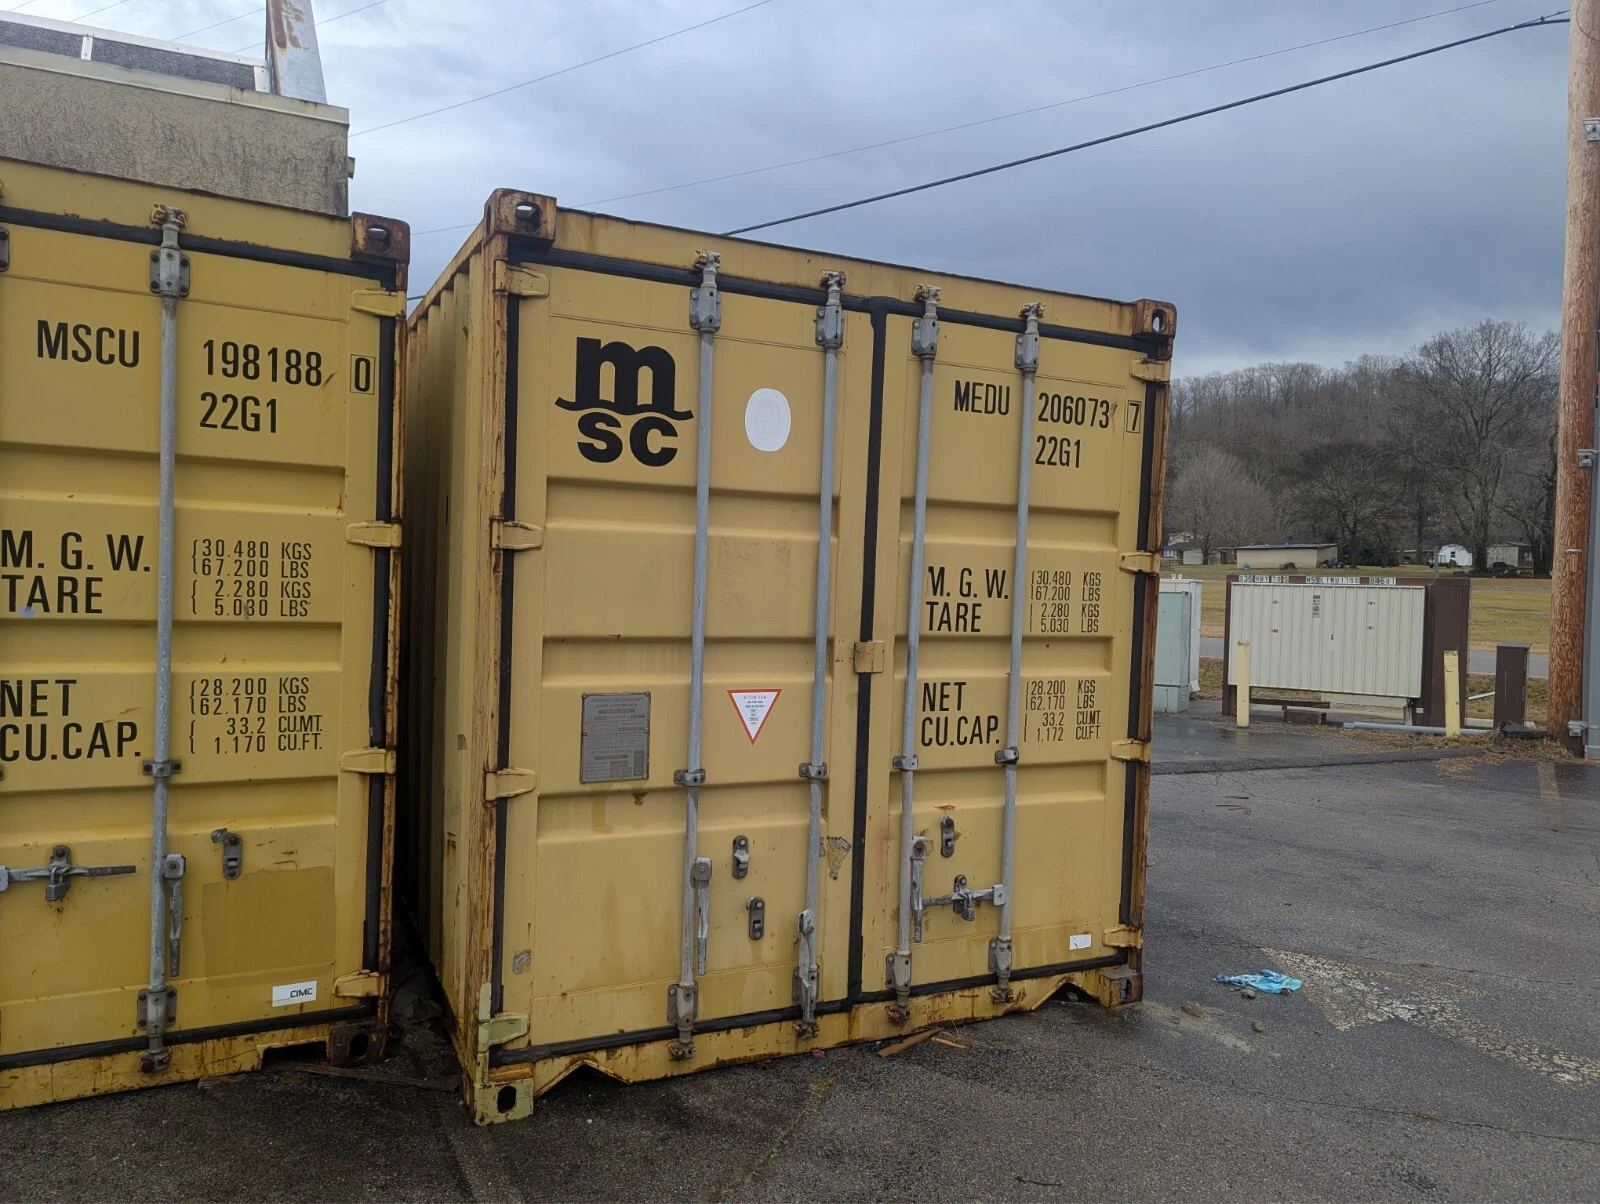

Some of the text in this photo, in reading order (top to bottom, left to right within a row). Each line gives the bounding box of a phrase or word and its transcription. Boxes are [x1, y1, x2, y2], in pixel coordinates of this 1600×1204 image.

[37, 319, 371, 392] MSCU 198188 0
[200, 391, 278, 434] 22G1
[953, 380, 1141, 431] MEDU 206073 7
[1035, 435, 1081, 469] 22G1
[281, 541, 312, 561] KGS
[281, 560, 309, 579] LBS
[1083, 571, 1101, 587] KGS
[2, 574, 103, 614] TARE
[281, 580, 311, 599] KGS
[1082, 586, 1101, 602] LBS
[280, 599, 308, 617] LBS
[926, 601, 982, 633] TARE
[1081, 603, 1100, 618] KGS
[1081, 618, 1099, 633] LBS
[279, 677, 310, 695] KGS
[1077, 679, 1096, 694] KGS
[0, 678, 77, 717] NET
[278, 695, 307, 713] LBS
[922, 681, 967, 712] NET
[1076, 694, 1095, 709] LBS
[226, 714, 323, 735] 33.2 CU.MT.
[1042, 711, 1064, 727] 33.2
[921, 714, 1000, 747] CU.CAP.
[1, 721, 141, 762] CU.CAP.
[277, 733, 323, 752] CU.FT.
[290, 988, 313, 998] CIMC
